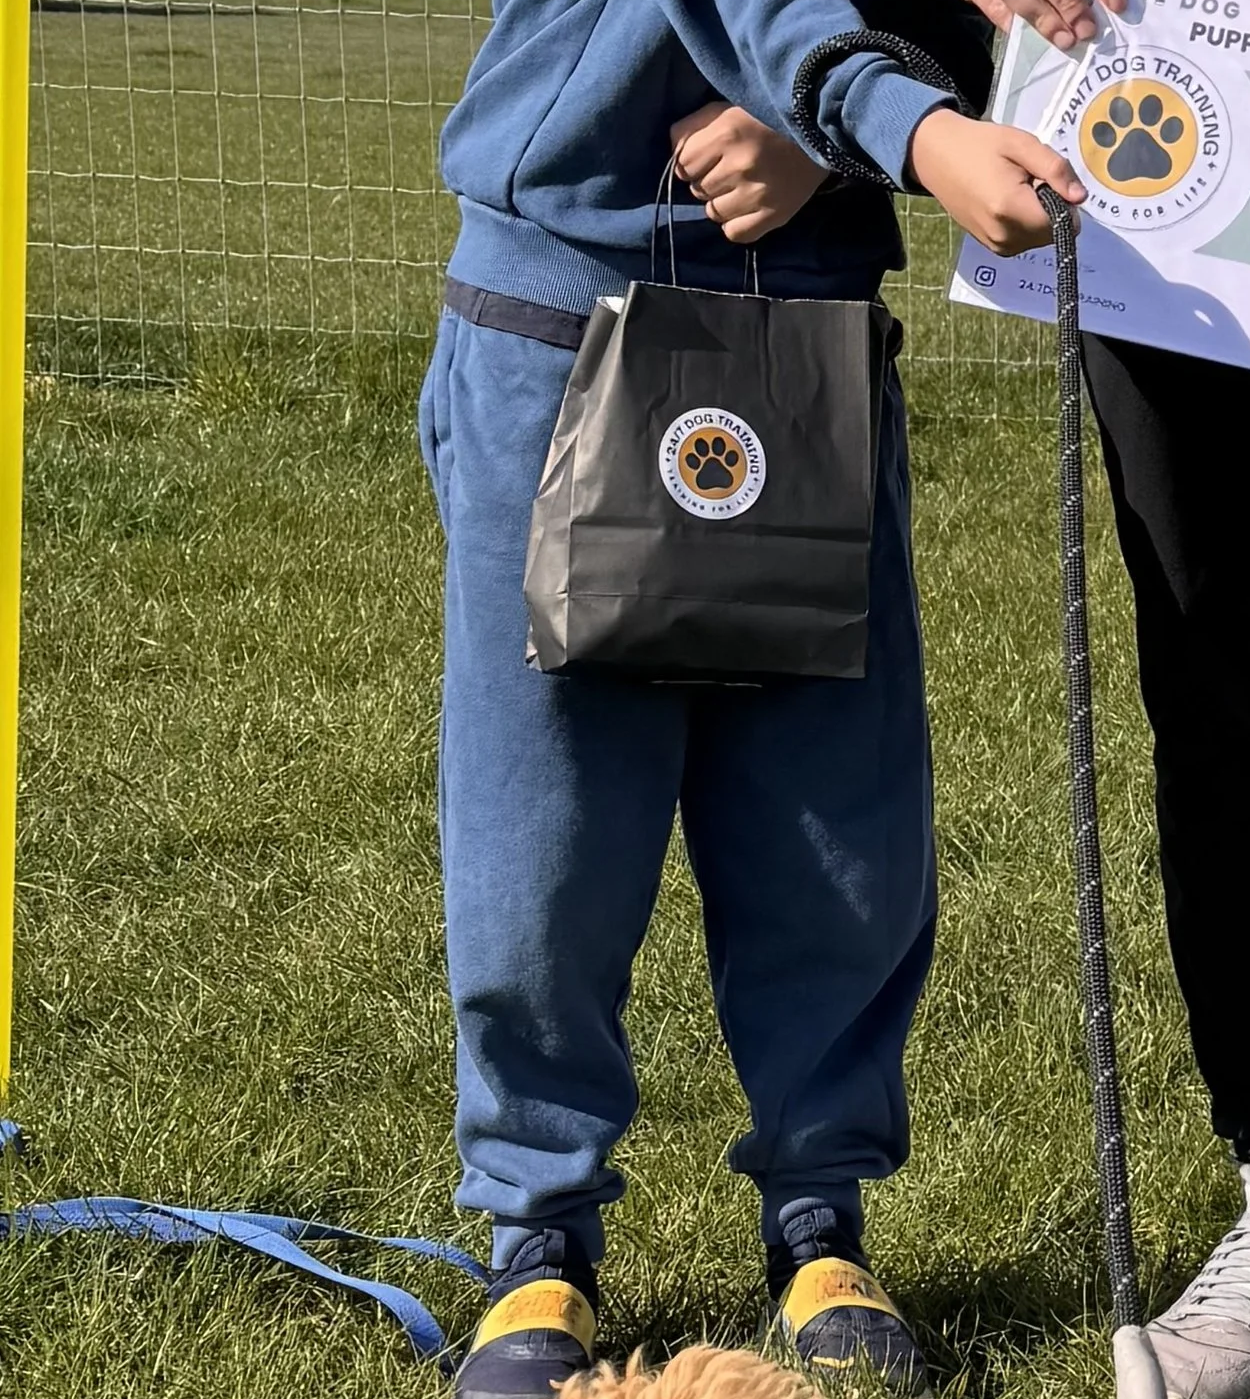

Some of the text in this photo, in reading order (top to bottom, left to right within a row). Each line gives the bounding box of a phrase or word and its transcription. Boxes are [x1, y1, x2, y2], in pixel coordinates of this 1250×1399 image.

[1061, 55, 1221, 158] 24/7 DOG TRAINING
[684, 413, 714, 430] DOG
